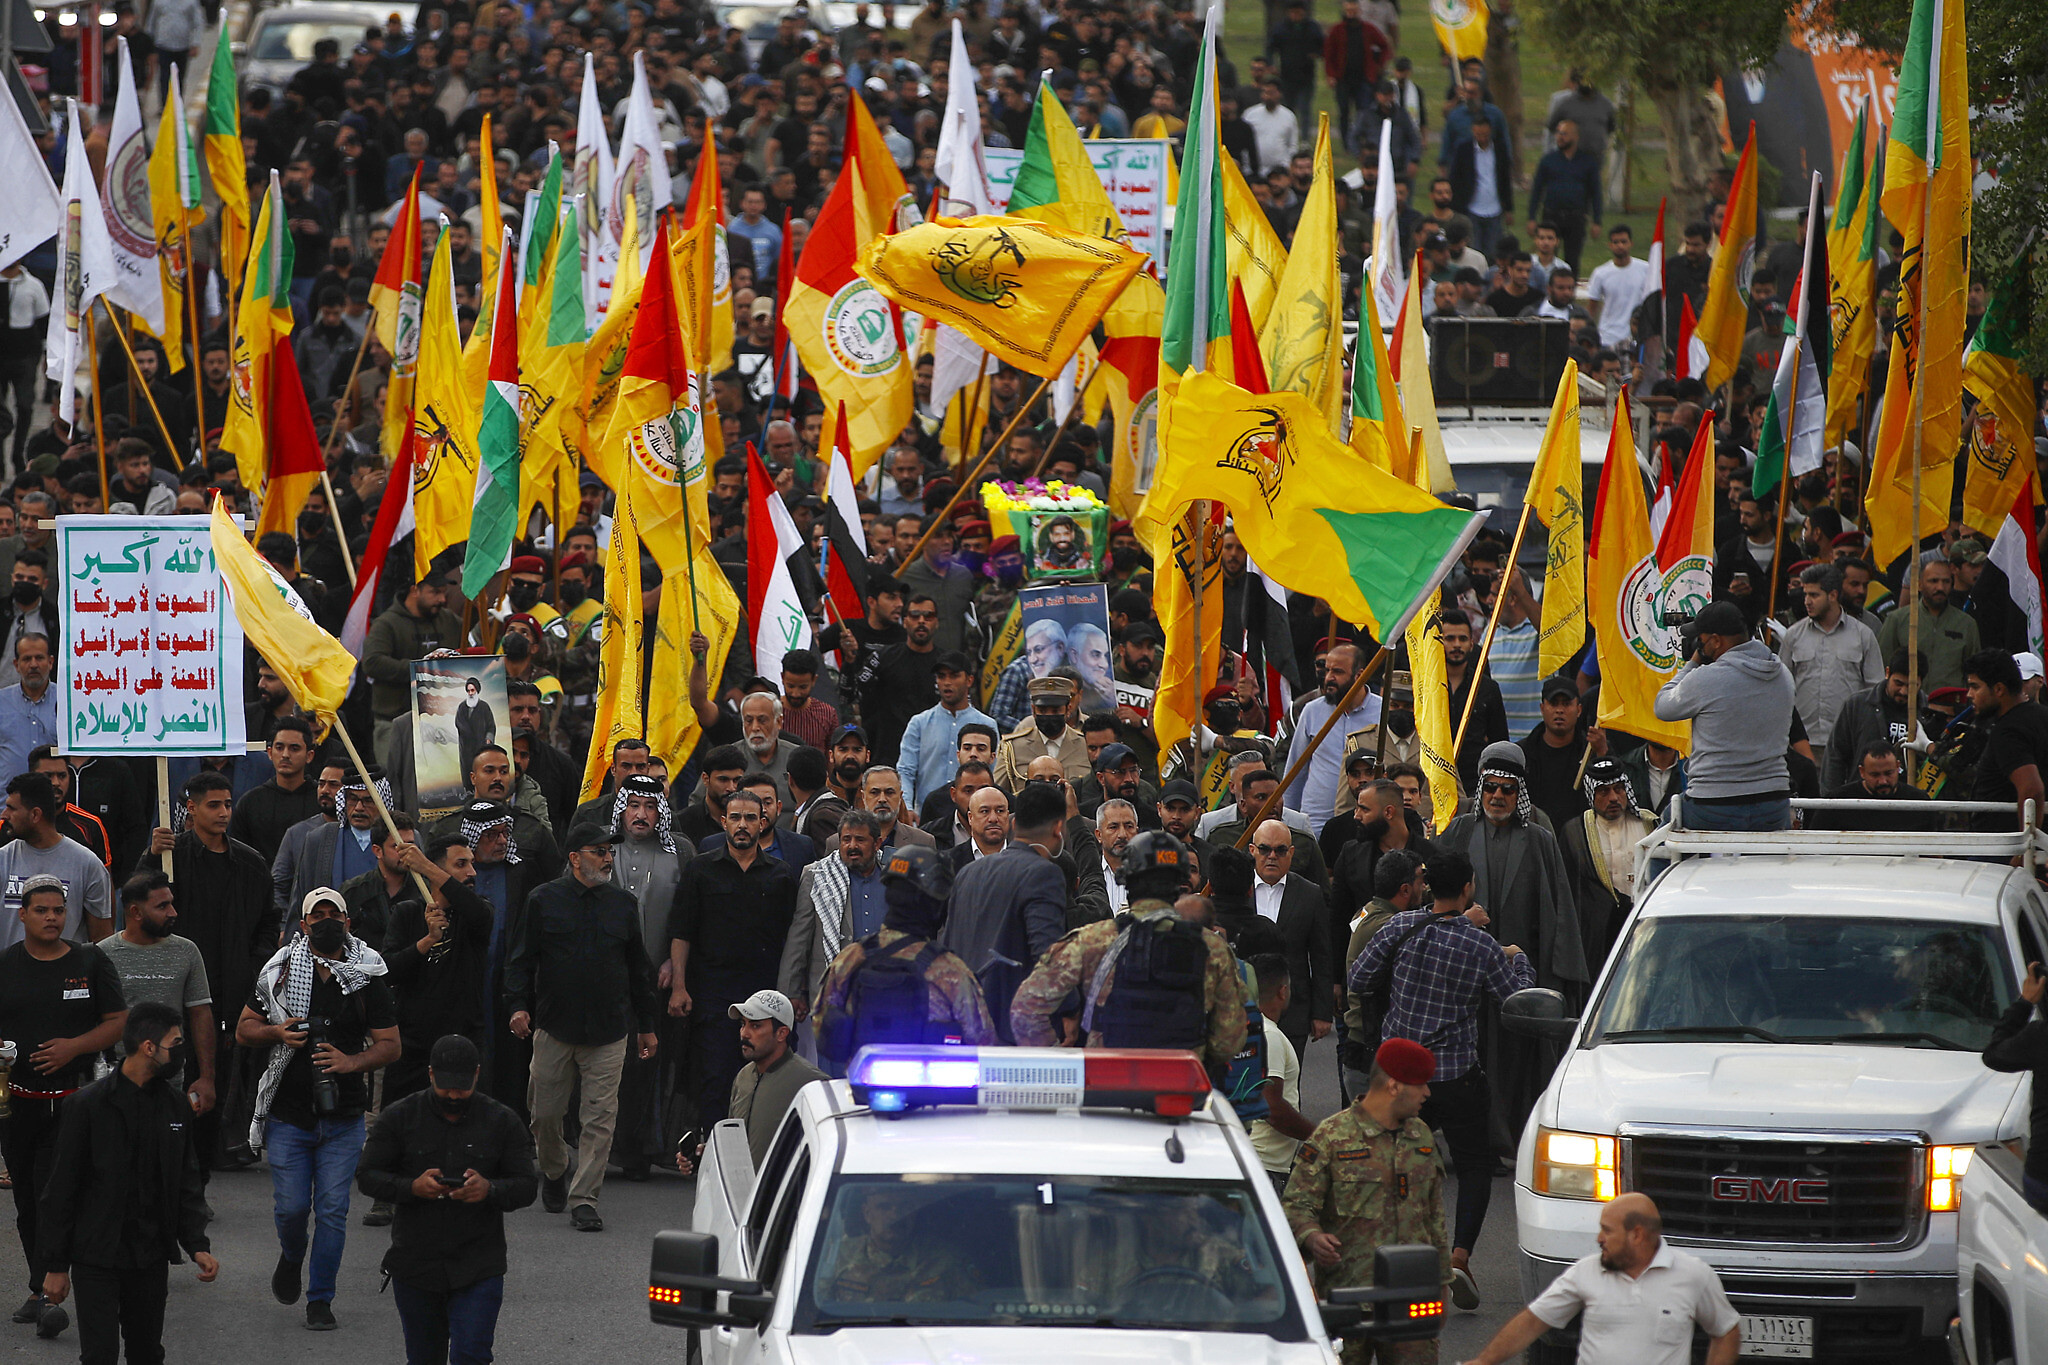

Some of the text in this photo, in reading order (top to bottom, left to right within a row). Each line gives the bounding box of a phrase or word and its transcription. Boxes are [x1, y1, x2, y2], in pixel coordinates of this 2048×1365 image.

[72, 532, 216, 586] الله أكبر
[73, 583, 215, 619] الموت لأمريكا
[73, 625, 215, 657] الموت لإسرائيل
[73, 665, 215, 696] اللعنة على اليهود
[75, 698, 218, 745] النصر للإسلام
[1037, 1182, 1053, 1204] 1
[1711, 1176, 1829, 1204] GMC
